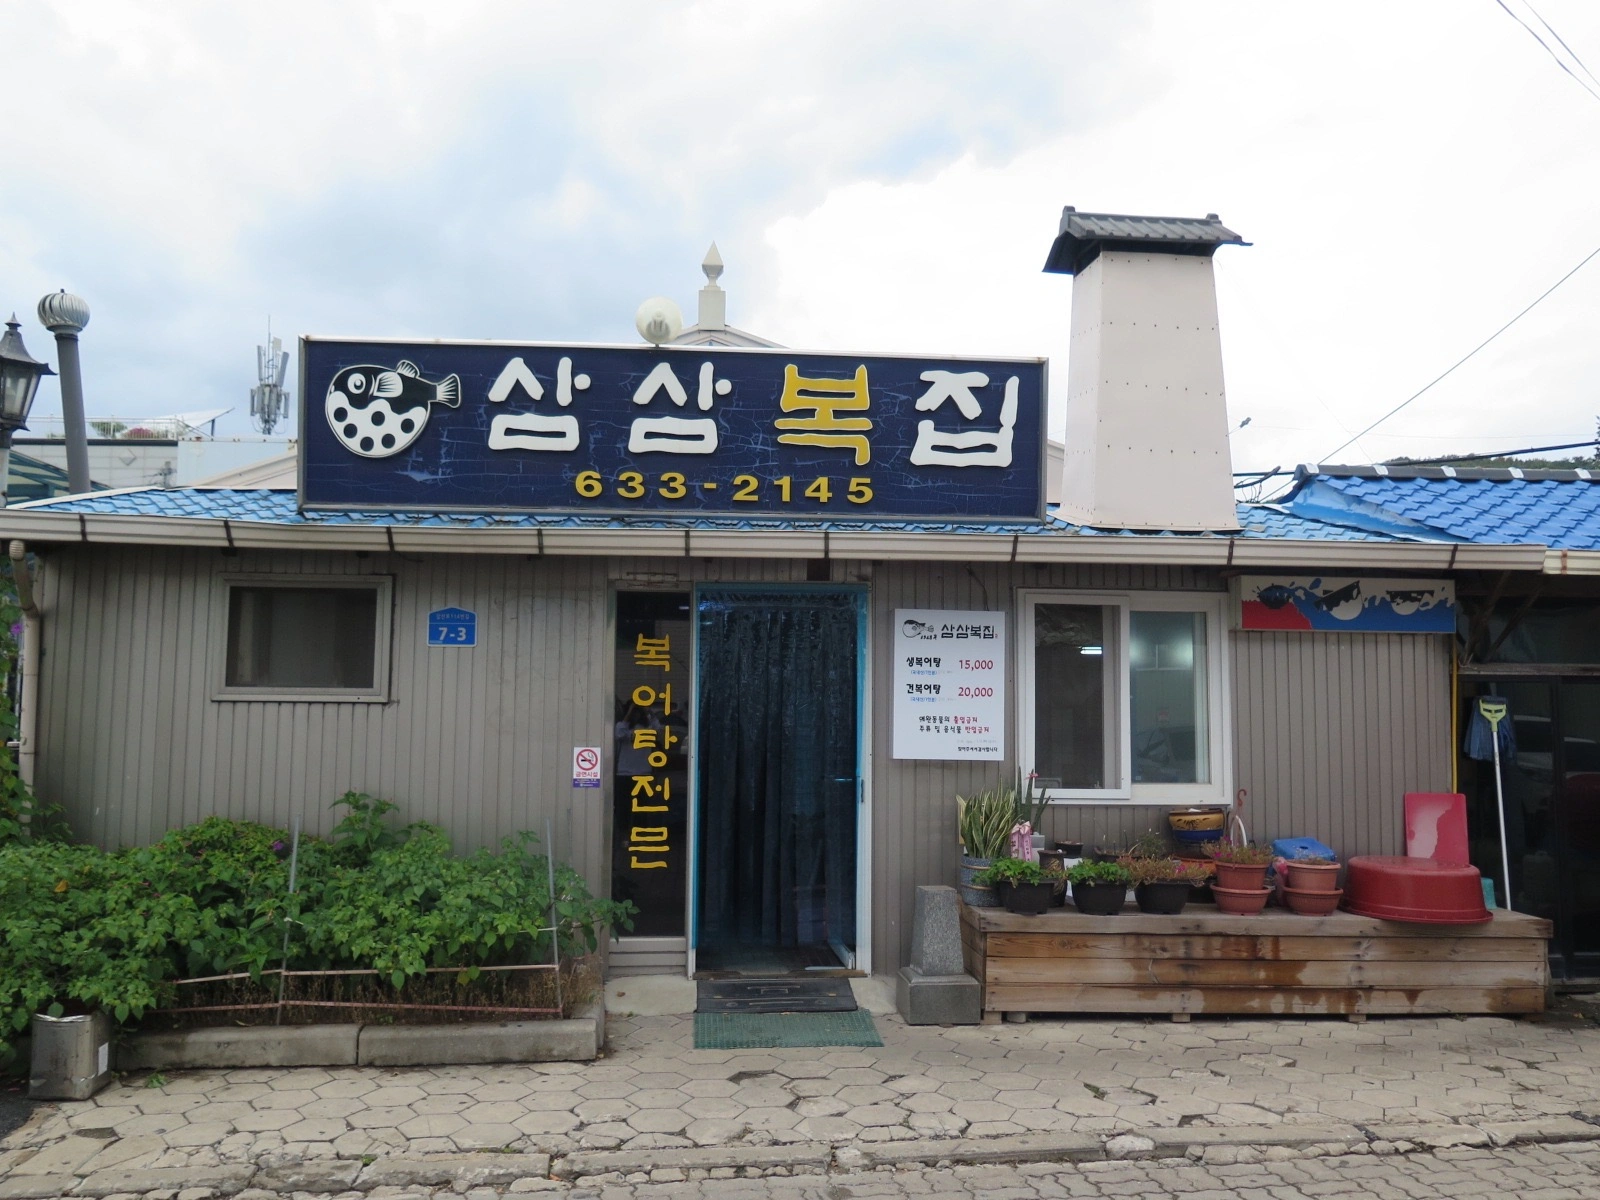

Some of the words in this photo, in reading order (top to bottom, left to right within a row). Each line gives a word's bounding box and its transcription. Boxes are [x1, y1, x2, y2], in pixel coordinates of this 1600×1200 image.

[488, 356, 1020, 469] 삼삼복집
[574, 470, 875, 505] 633-2145
[438, 627, 467, 641] 7-3
[941, 623, 995, 639] 삼삼복집
[906, 657, 942, 668] 생복어탕
[958, 660, 994, 671] 15,000
[906, 683, 942, 695] 건복어탕
[957, 686, 994, 699] 20,000
[628, 633, 678, 869] 복어탕전문
